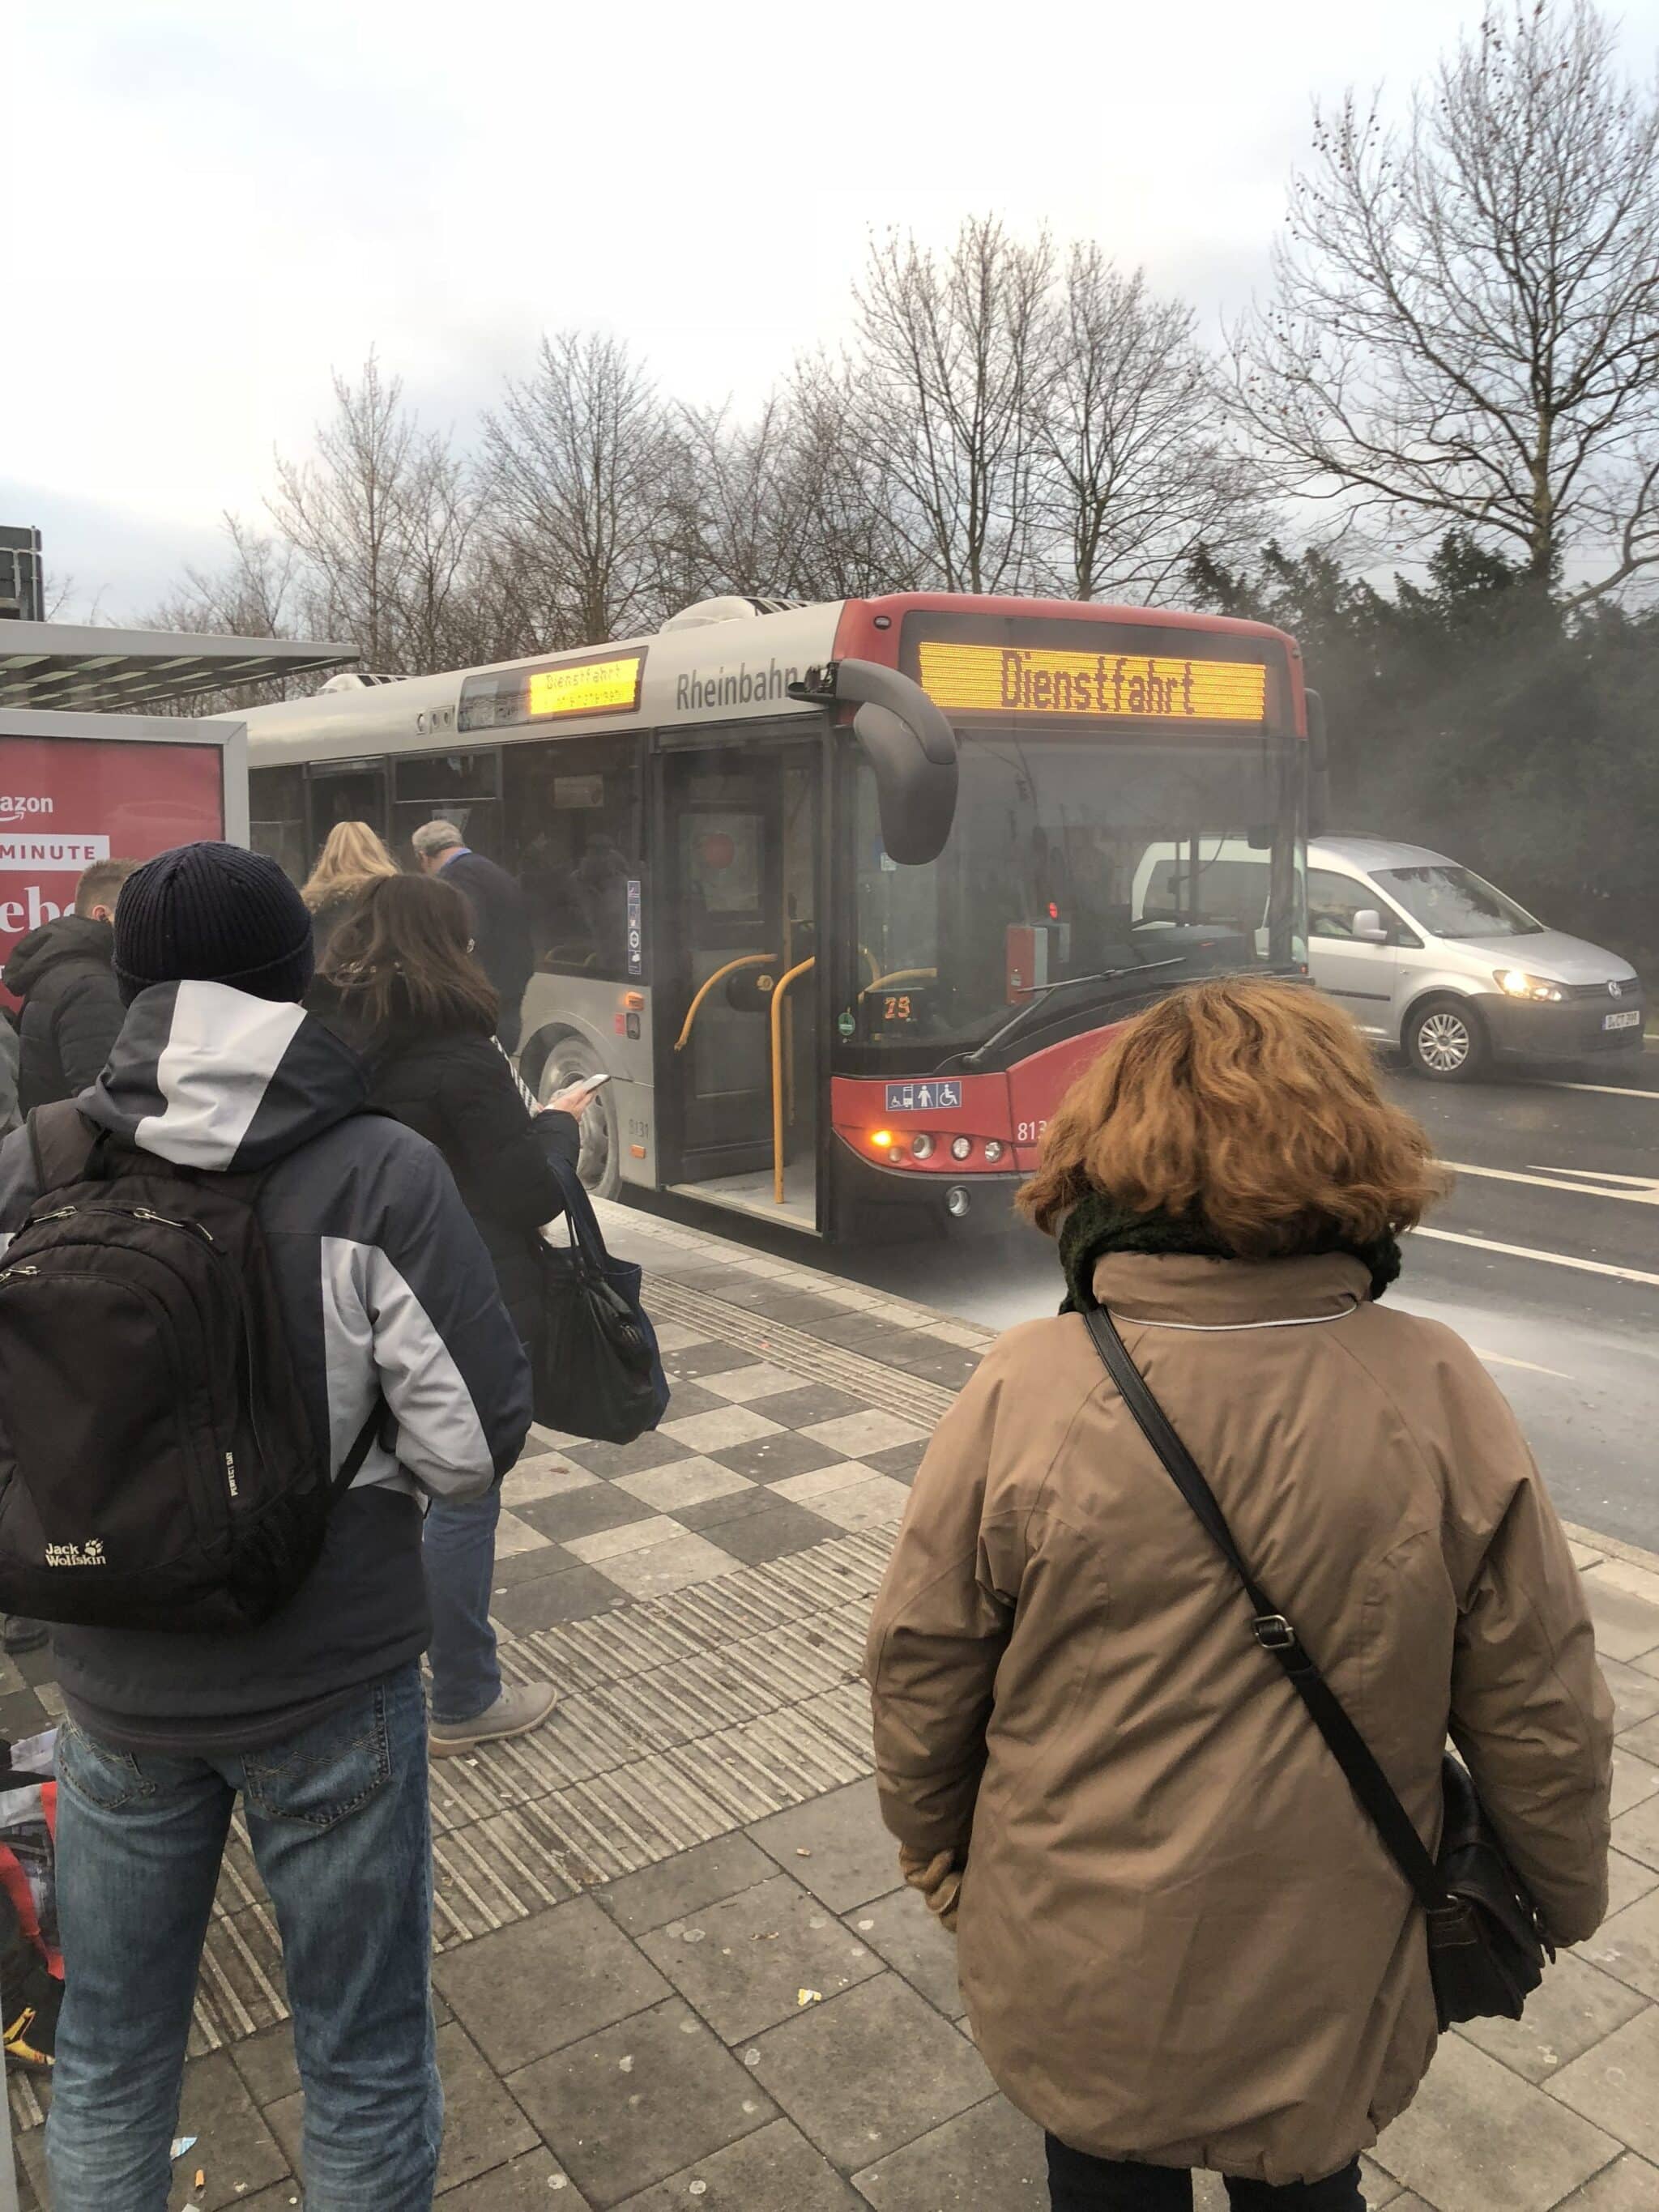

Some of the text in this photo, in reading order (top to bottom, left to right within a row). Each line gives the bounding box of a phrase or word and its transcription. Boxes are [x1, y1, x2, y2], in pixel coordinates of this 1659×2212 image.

[676, 657, 799, 710] Rheinbahn
[1001, 650, 1195, 715] Dienstfahrt
[0, 844, 96, 860] MINUTE
[228, 1465, 239, 1497] PERFECT
[45, 1542, 79, 1555] Jack
[45, 1554, 106, 1567] Wolfskin
